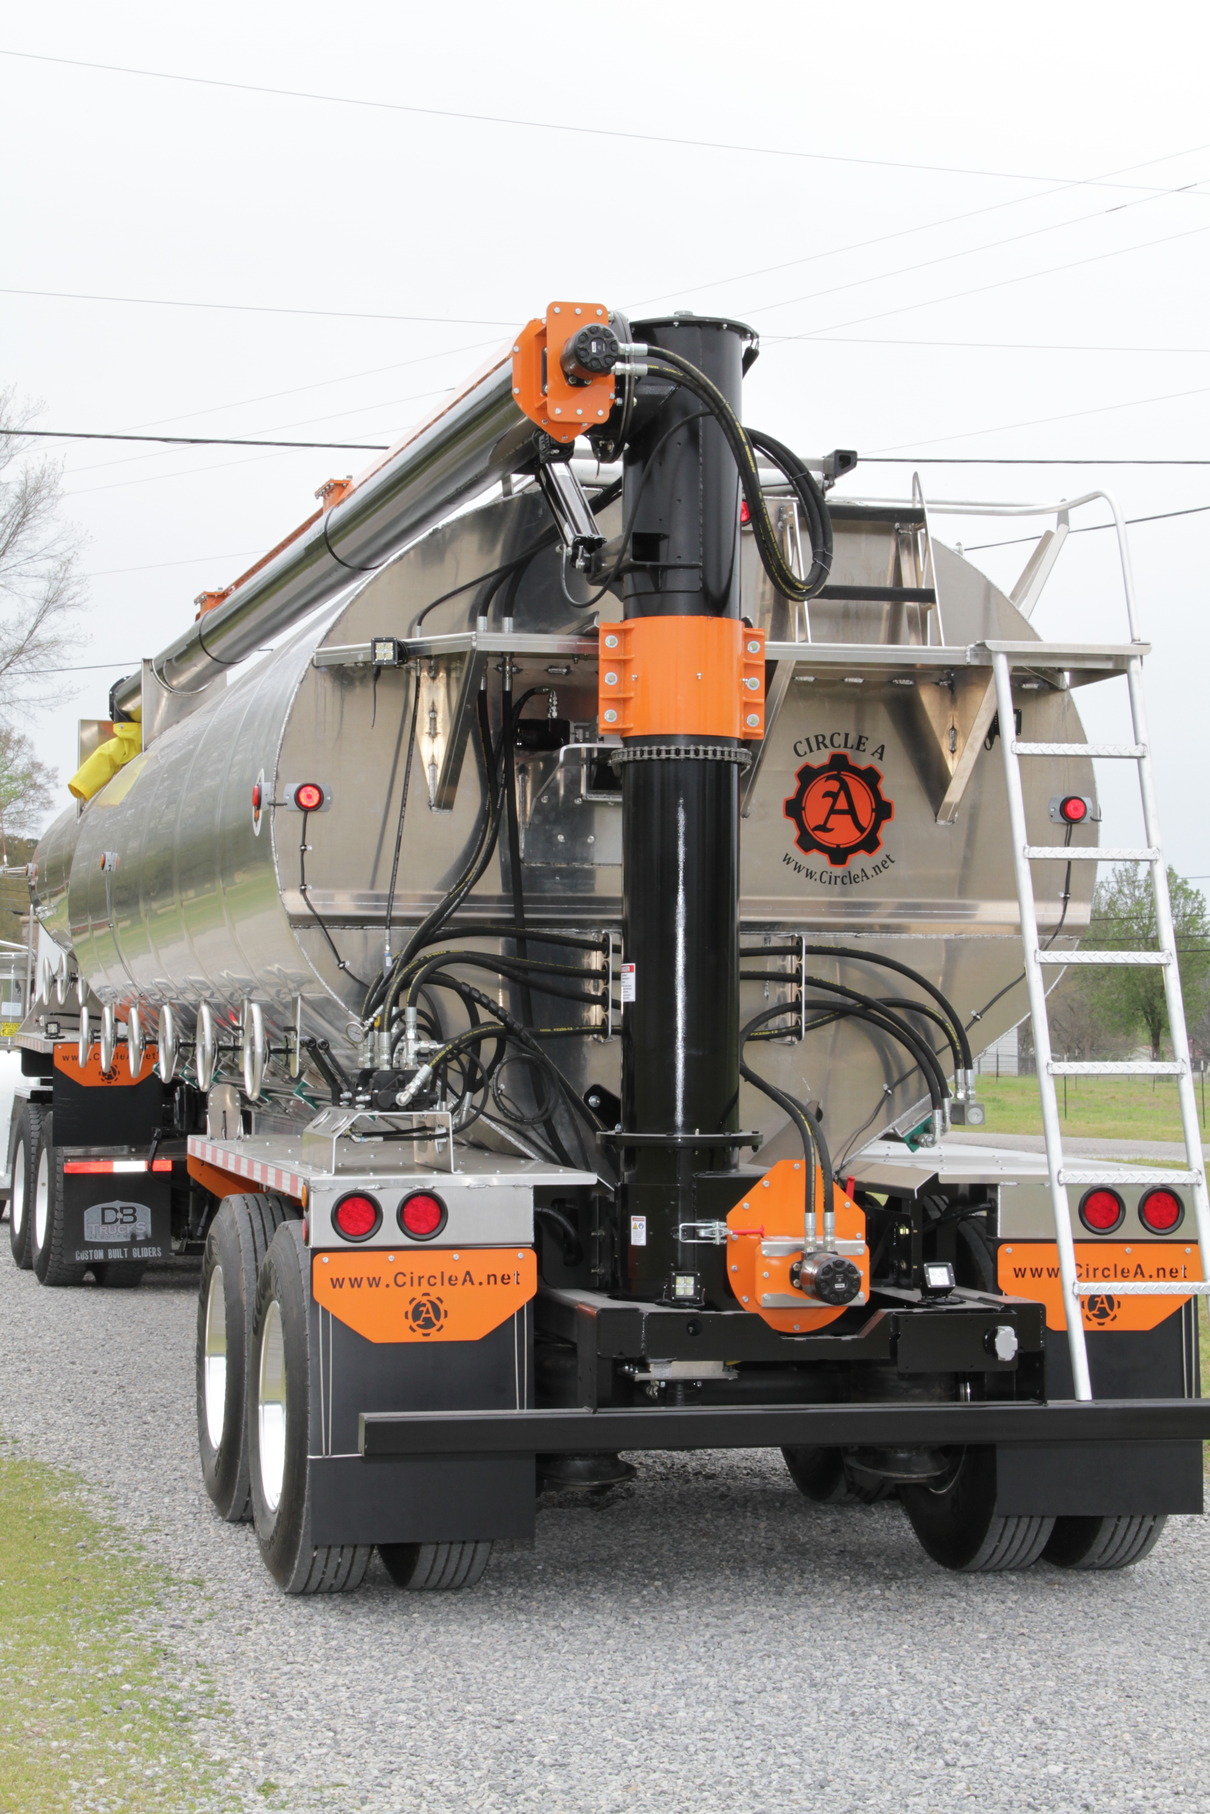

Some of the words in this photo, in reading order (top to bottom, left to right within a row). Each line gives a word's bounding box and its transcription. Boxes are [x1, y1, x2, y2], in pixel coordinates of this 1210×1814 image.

[793, 732, 869, 758] CIRCLE
[870, 744, 886, 761] A
[811, 773, 868, 835] A
[782, 852, 896, 886] www.CircleA.net
[75, 1249, 104, 1261] CUSTOM
[108, 1247, 128, 1259] BUILT
[132, 1246, 162, 1258] GLIDERS
[330, 1270, 521, 1289] www.CircleA.net
[1013, 1263, 1188, 1279] wwwCircleA.net
